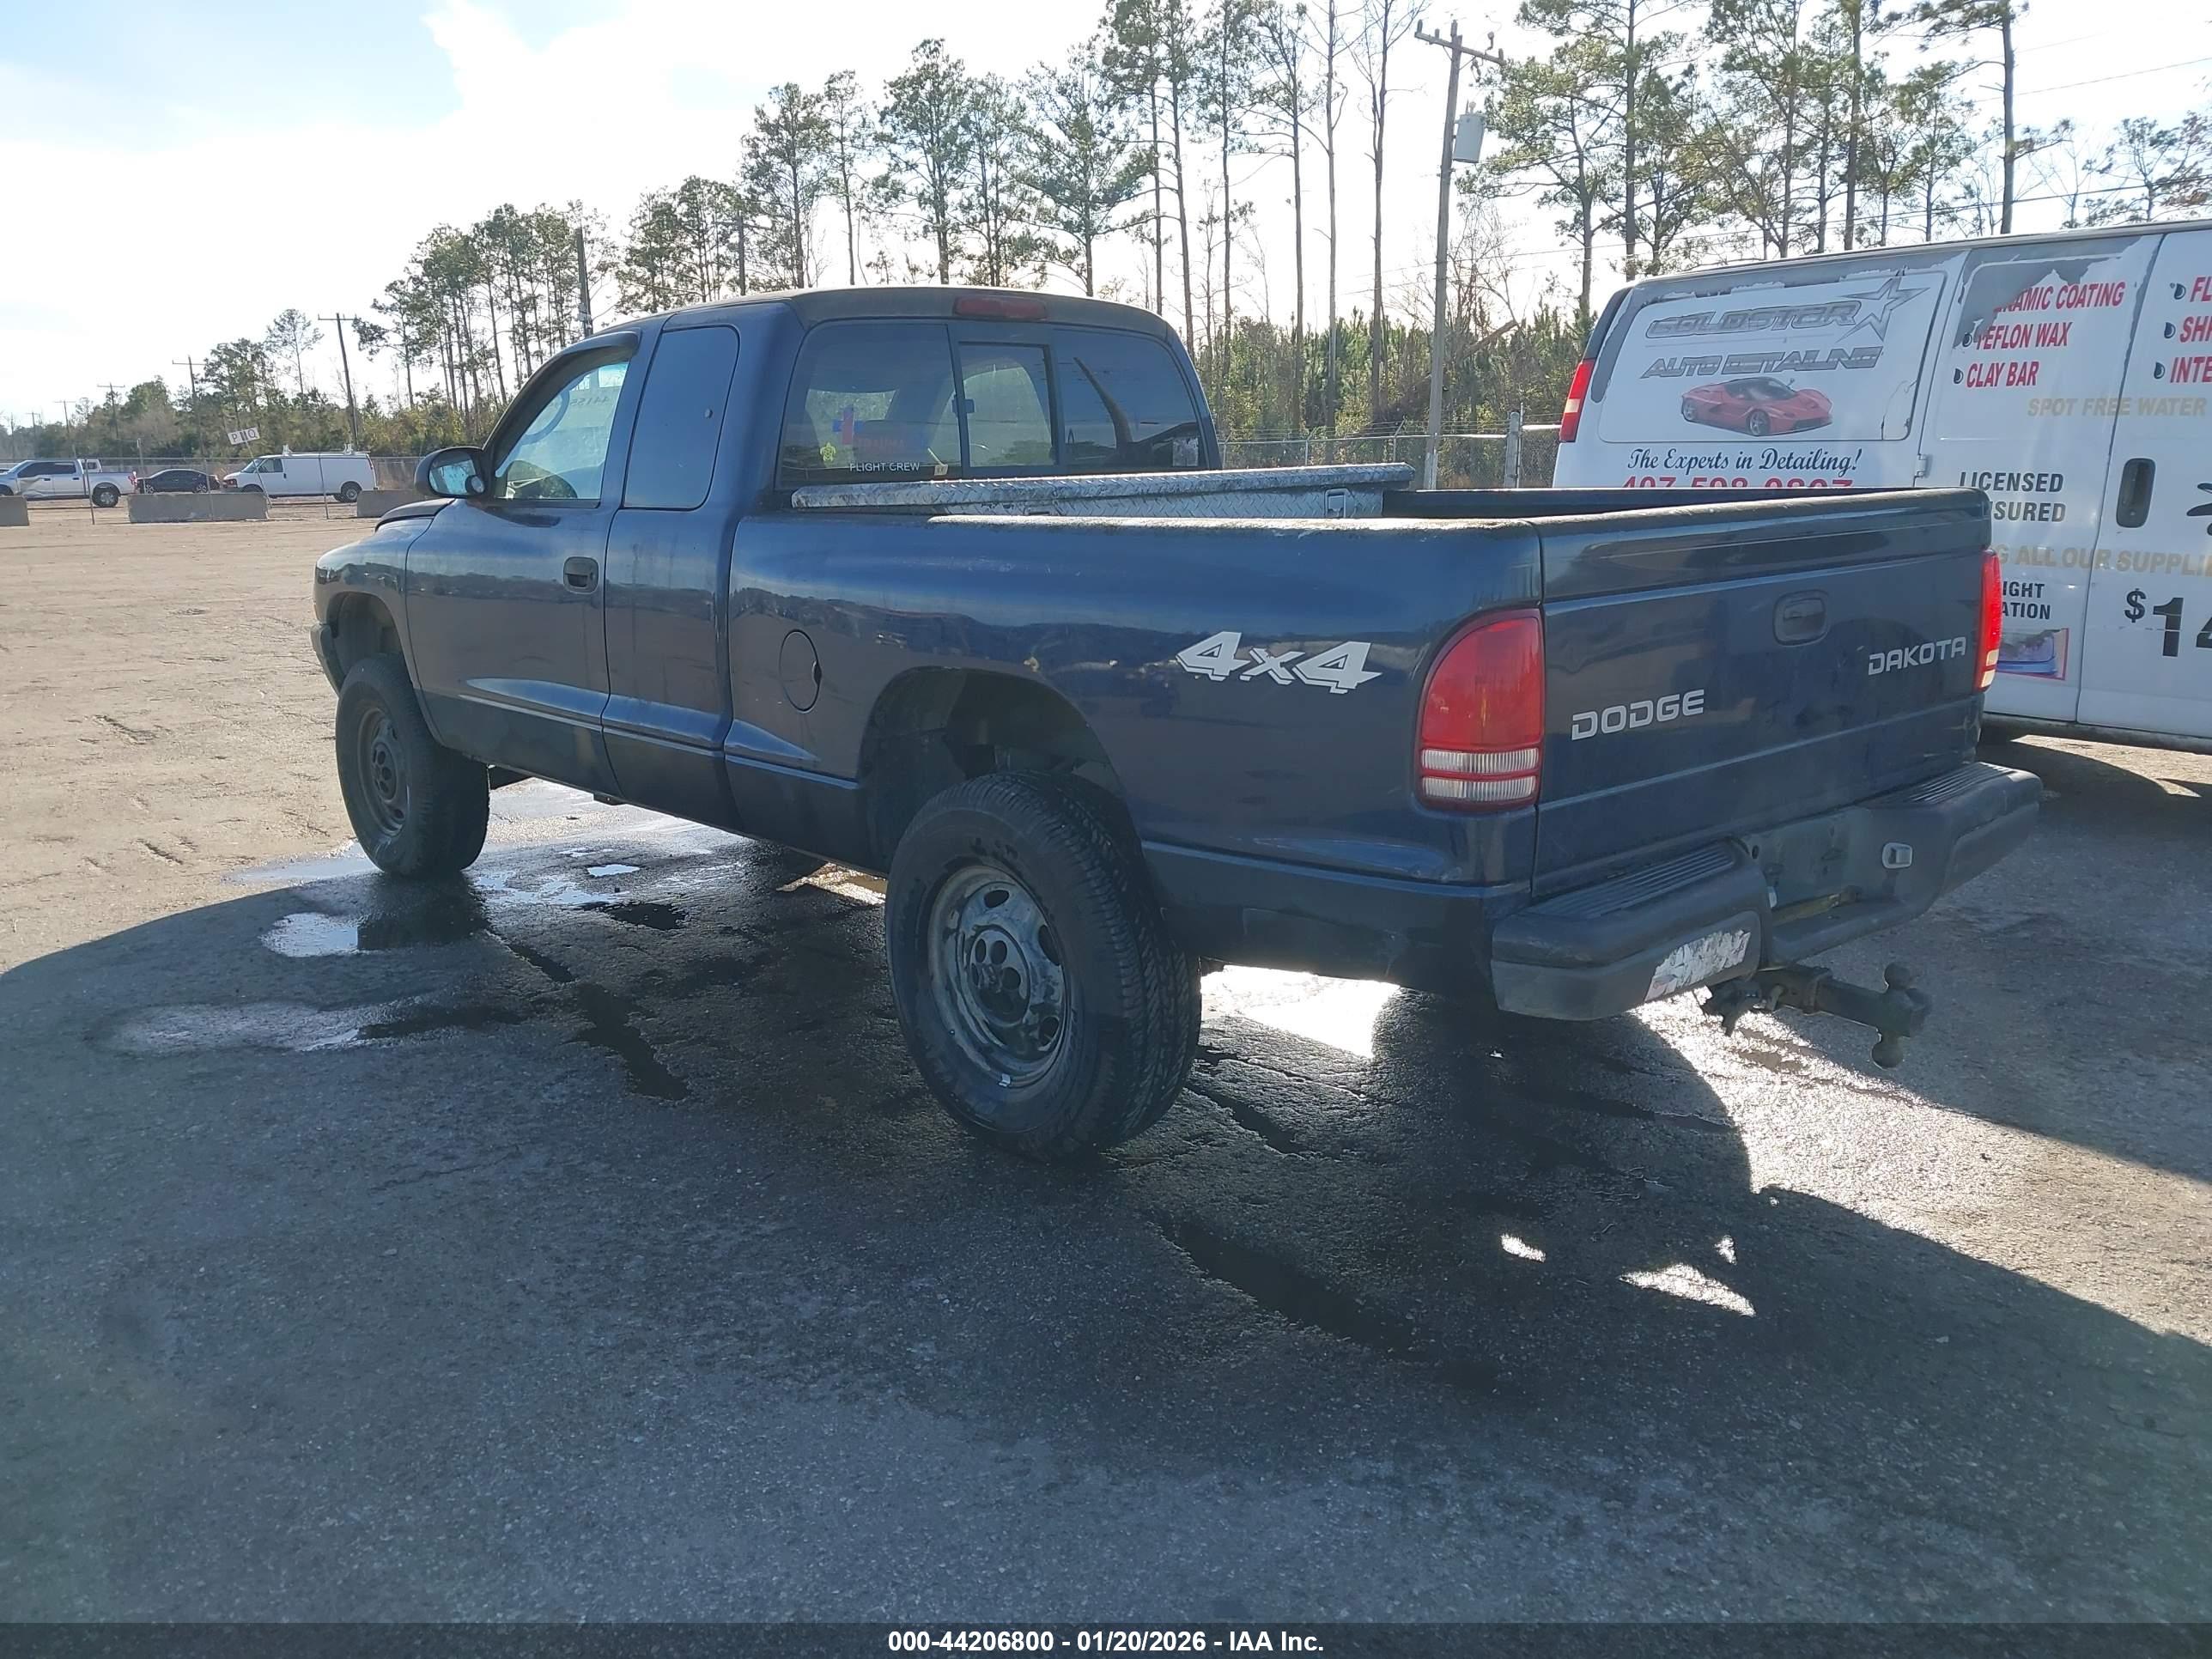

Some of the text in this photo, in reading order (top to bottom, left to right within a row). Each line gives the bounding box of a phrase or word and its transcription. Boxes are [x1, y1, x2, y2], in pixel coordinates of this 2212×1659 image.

[2056, 282, 2126, 310] COATING
[2035, 321, 2073, 347] WAX
[2179, 315, 2212, 343] SH
[1640, 356, 1723, 379] AUTO
[1966, 361, 2039, 387] CLAY BAR
[2027, 398, 2207, 416] SPOT FREE WATER
[849, 462, 921, 472] FLIGHT CREW
[1627, 447, 1863, 477] The Experts in Detailing!
[1959, 471, 2064, 492] LICENSED
[1990, 501, 2066, 522] SURED
[2015, 545, 2057, 567] ALL
[2062, 547, 2112, 570] OUR
[2002, 580, 2045, 599] IGHT
[2002, 601, 2051, 620] ATION
[1176, 631, 1382, 694] 4x4
[1868, 636, 1966, 676] DAKOTA
[1571, 689, 1705, 740] DODGE
